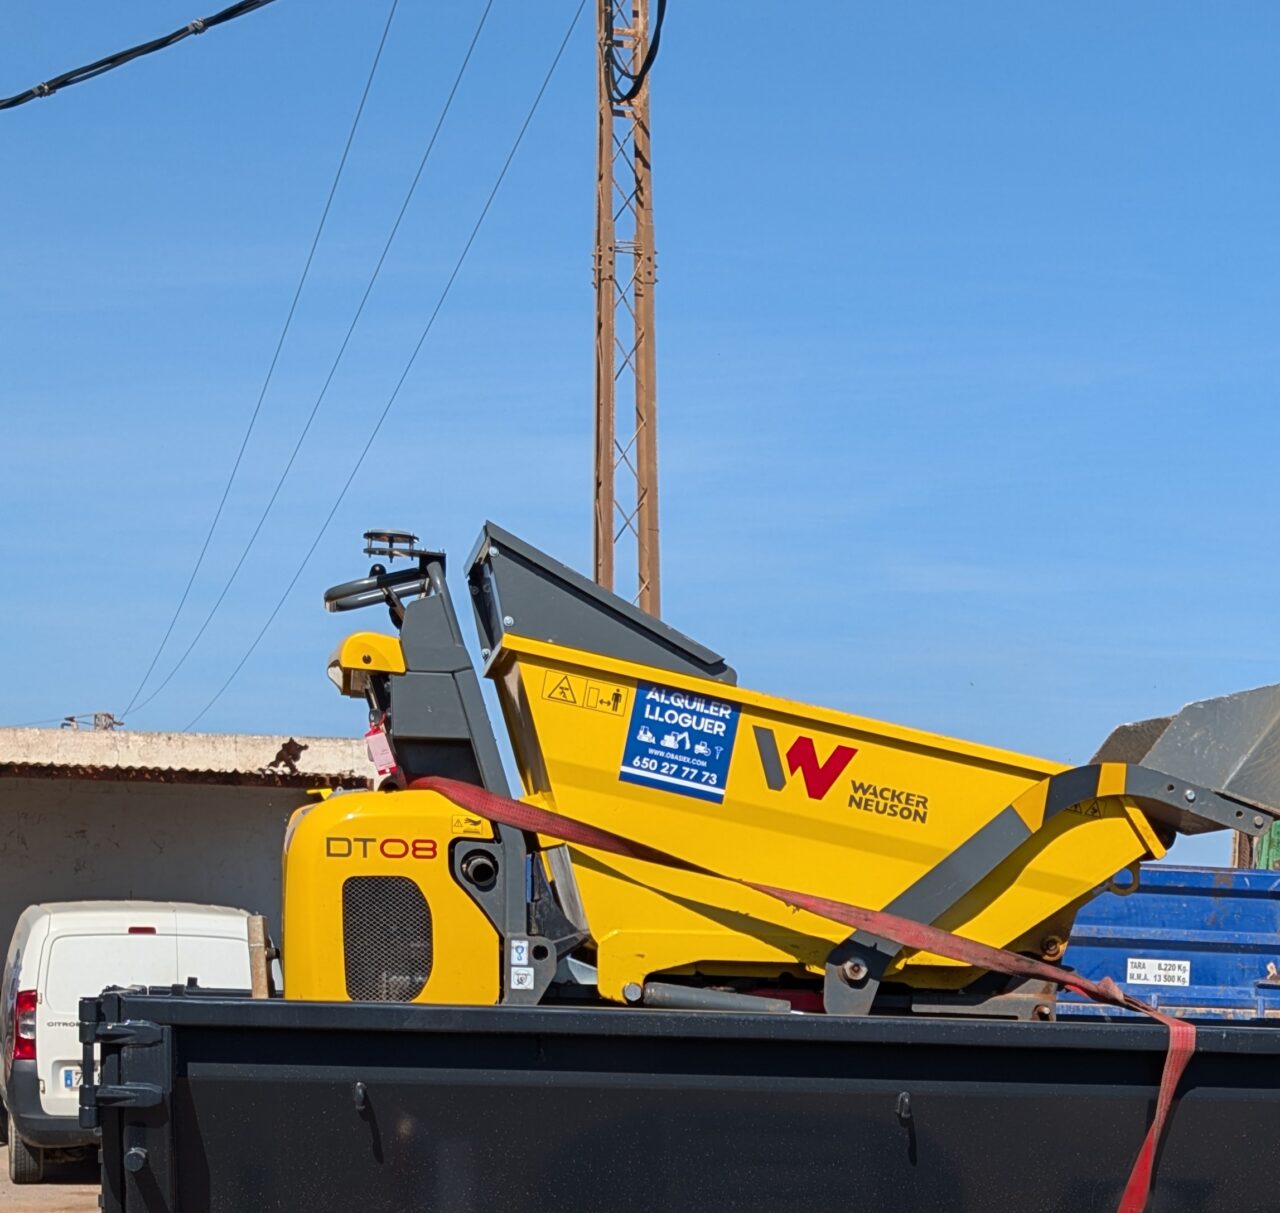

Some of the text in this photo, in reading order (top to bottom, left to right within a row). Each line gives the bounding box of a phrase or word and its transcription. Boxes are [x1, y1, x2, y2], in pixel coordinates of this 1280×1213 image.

[645, 687, 732, 720] ALQUILER
[644, 704, 726, 737] LLOGUER
[632, 755, 718, 785] 650 27 77 73
[847, 794, 928, 825] NEUSON
[851, 779, 929, 810] WACKER
[1130, 961, 1146, 970] TARA
